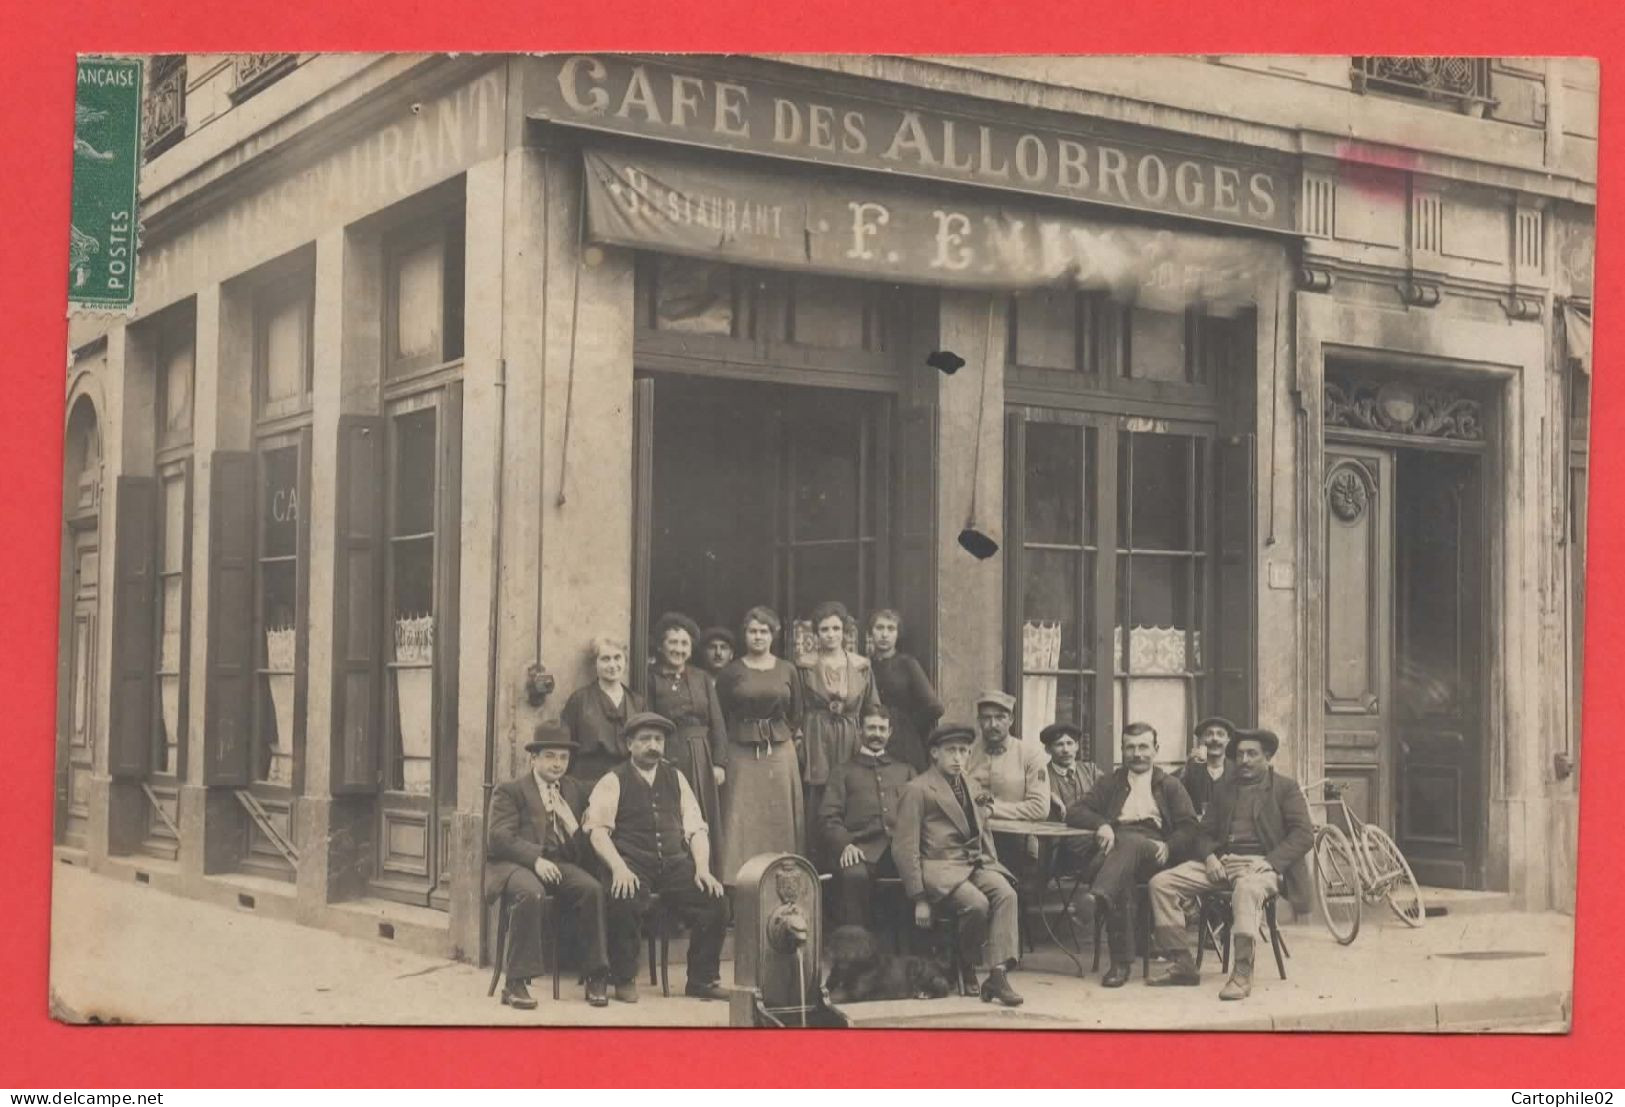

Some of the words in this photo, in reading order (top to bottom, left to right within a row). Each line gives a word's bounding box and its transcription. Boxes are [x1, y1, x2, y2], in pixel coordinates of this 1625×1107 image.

[556, 56, 752, 138] CAFE
[773, 98, 869, 154] DES
[879, 108, 1276, 220] ALLOBROGES
[107, 210, 129, 289] POSTES
